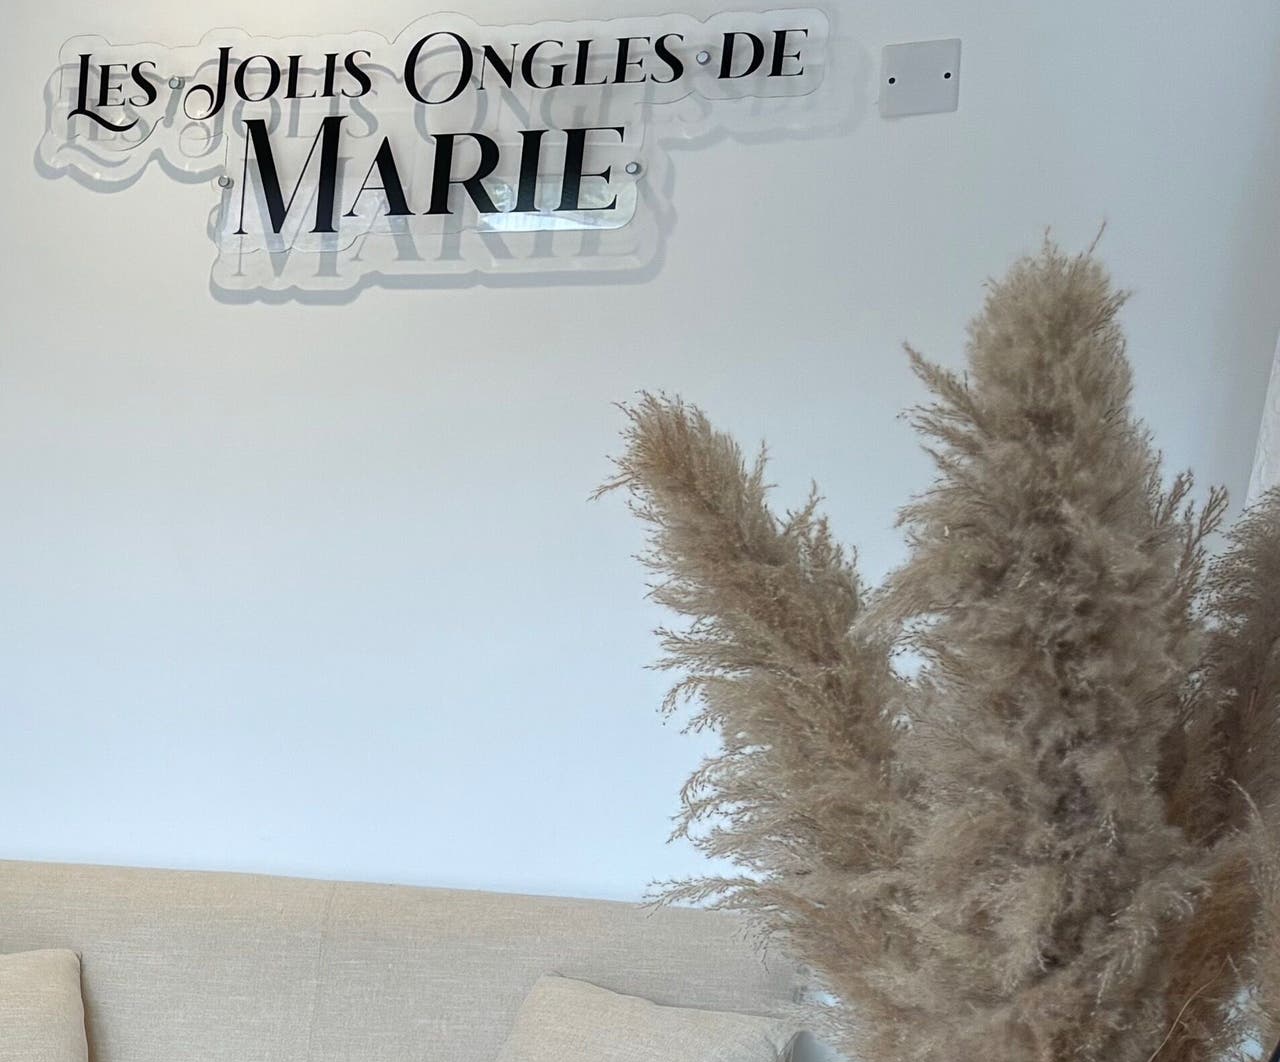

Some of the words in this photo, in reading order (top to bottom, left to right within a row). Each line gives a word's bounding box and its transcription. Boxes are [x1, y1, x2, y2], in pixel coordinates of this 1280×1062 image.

[67, 53, 157, 132] LES
[183, 46, 372, 121] JOLIS
[403, 31, 685, 105] ONGLES
[717, 29, 809, 80] DE
[233, 115, 625, 236] MARIE
